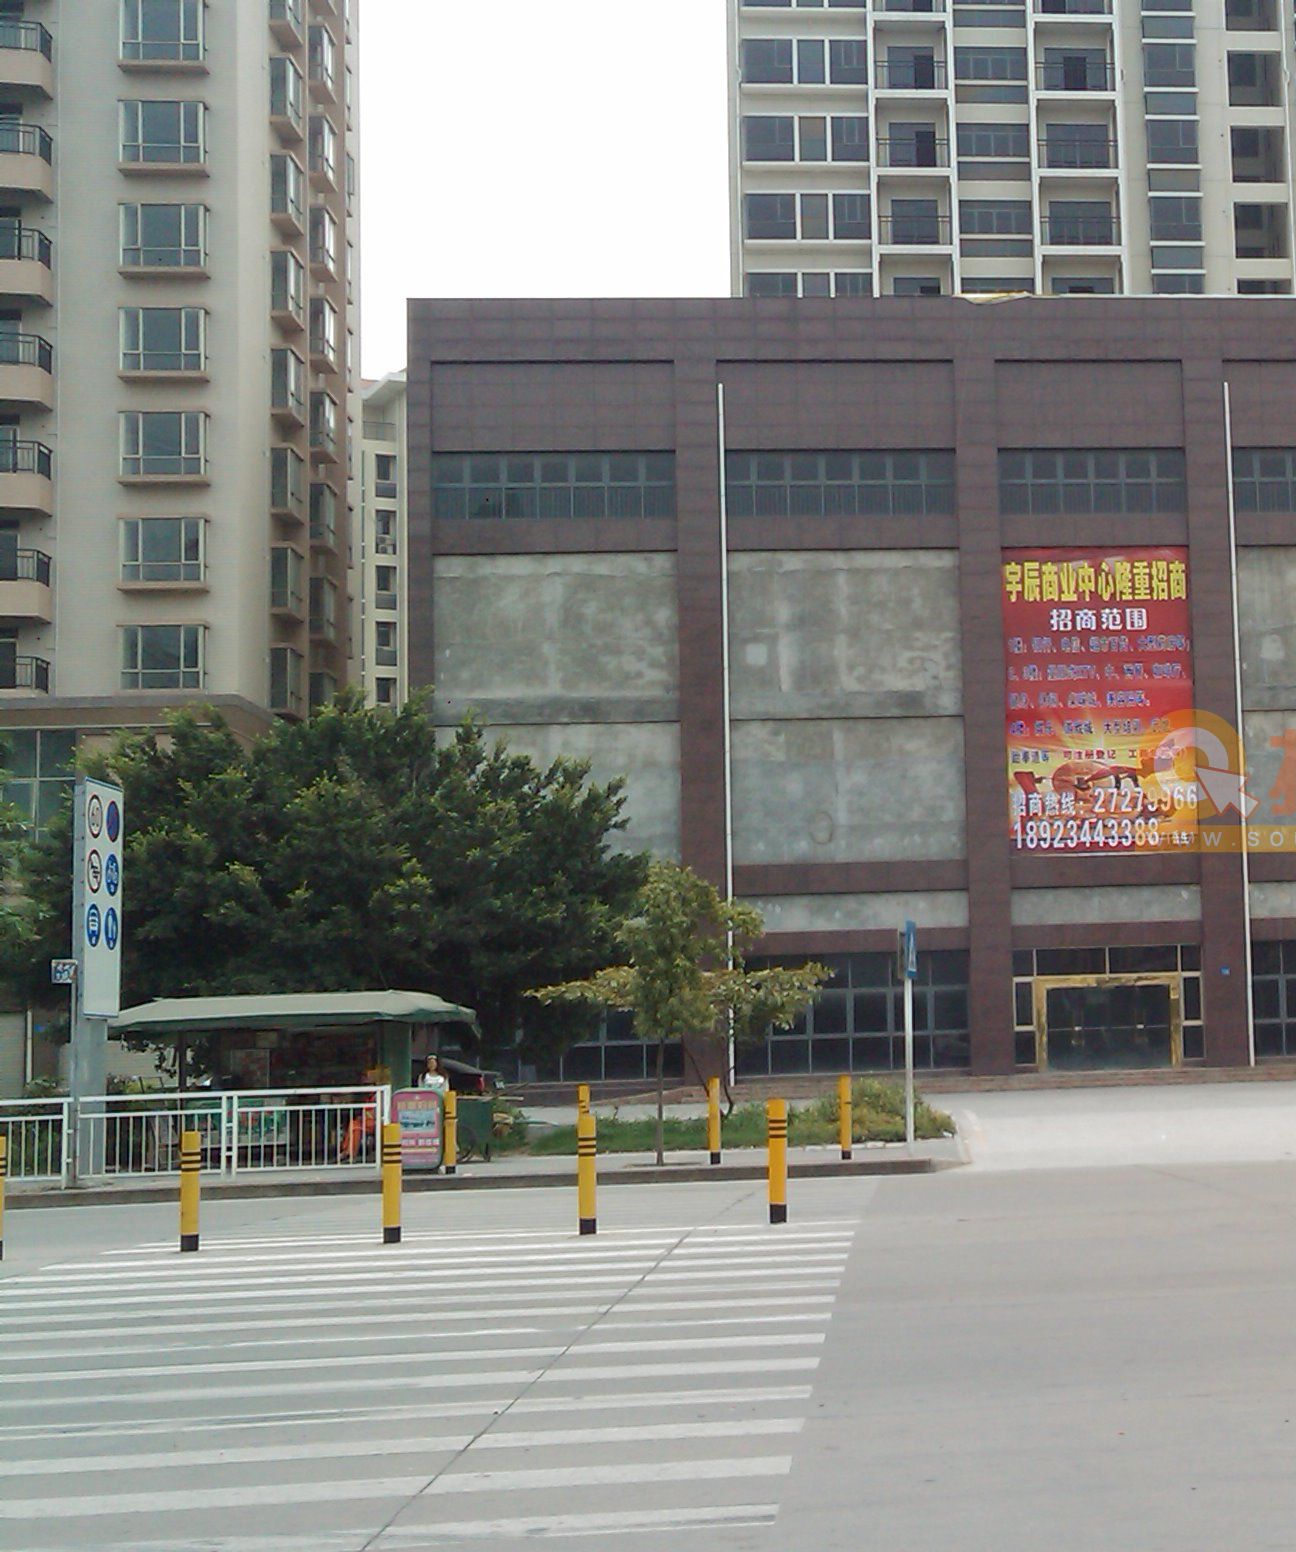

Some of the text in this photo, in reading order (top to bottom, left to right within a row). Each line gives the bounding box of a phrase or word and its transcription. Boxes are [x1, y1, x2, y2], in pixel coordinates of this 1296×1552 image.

[1004, 560, 1187, 602] 宇辰商业中心隆重招商
[1049, 607, 1148, 631] 招商范围
[1013, 818, 1159, 849] 18923443388
